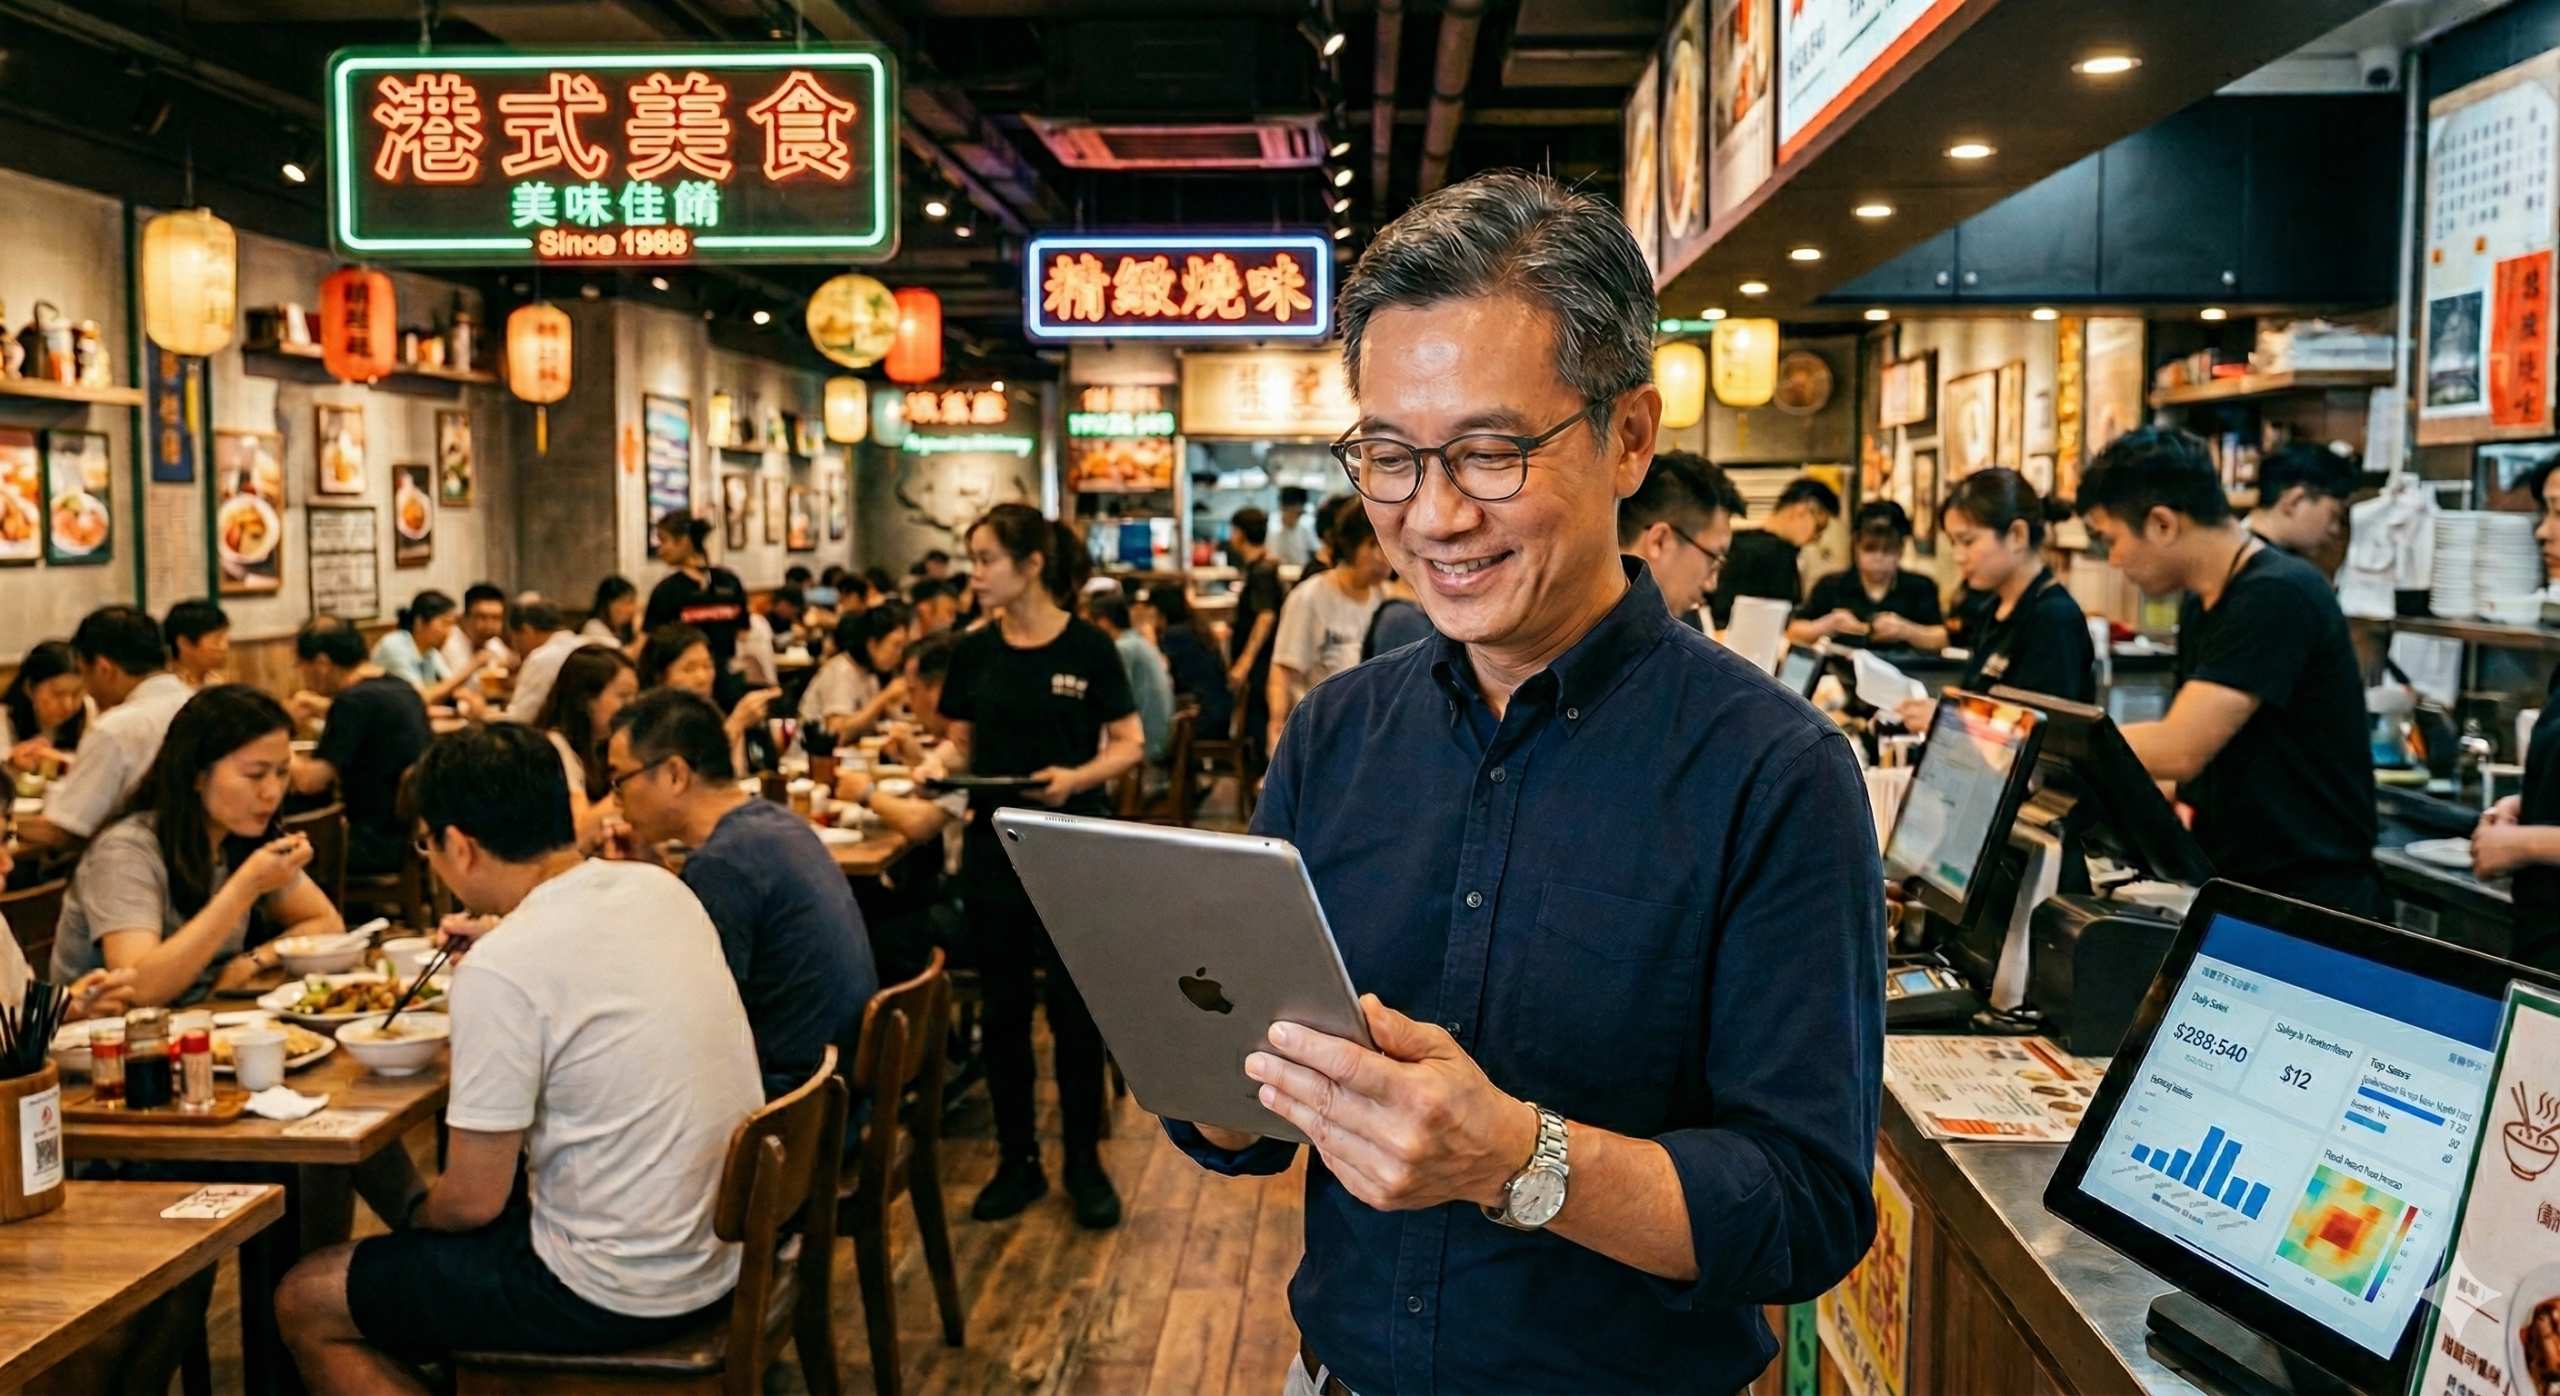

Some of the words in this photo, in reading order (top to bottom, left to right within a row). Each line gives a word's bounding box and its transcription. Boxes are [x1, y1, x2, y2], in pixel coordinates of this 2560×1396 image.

[372, 70, 855, 181] 港式美食
[538, 229, 617, 257] Since
[621, 228, 688, 256] 1988
[2279, 1064, 2312, 1091] $12
